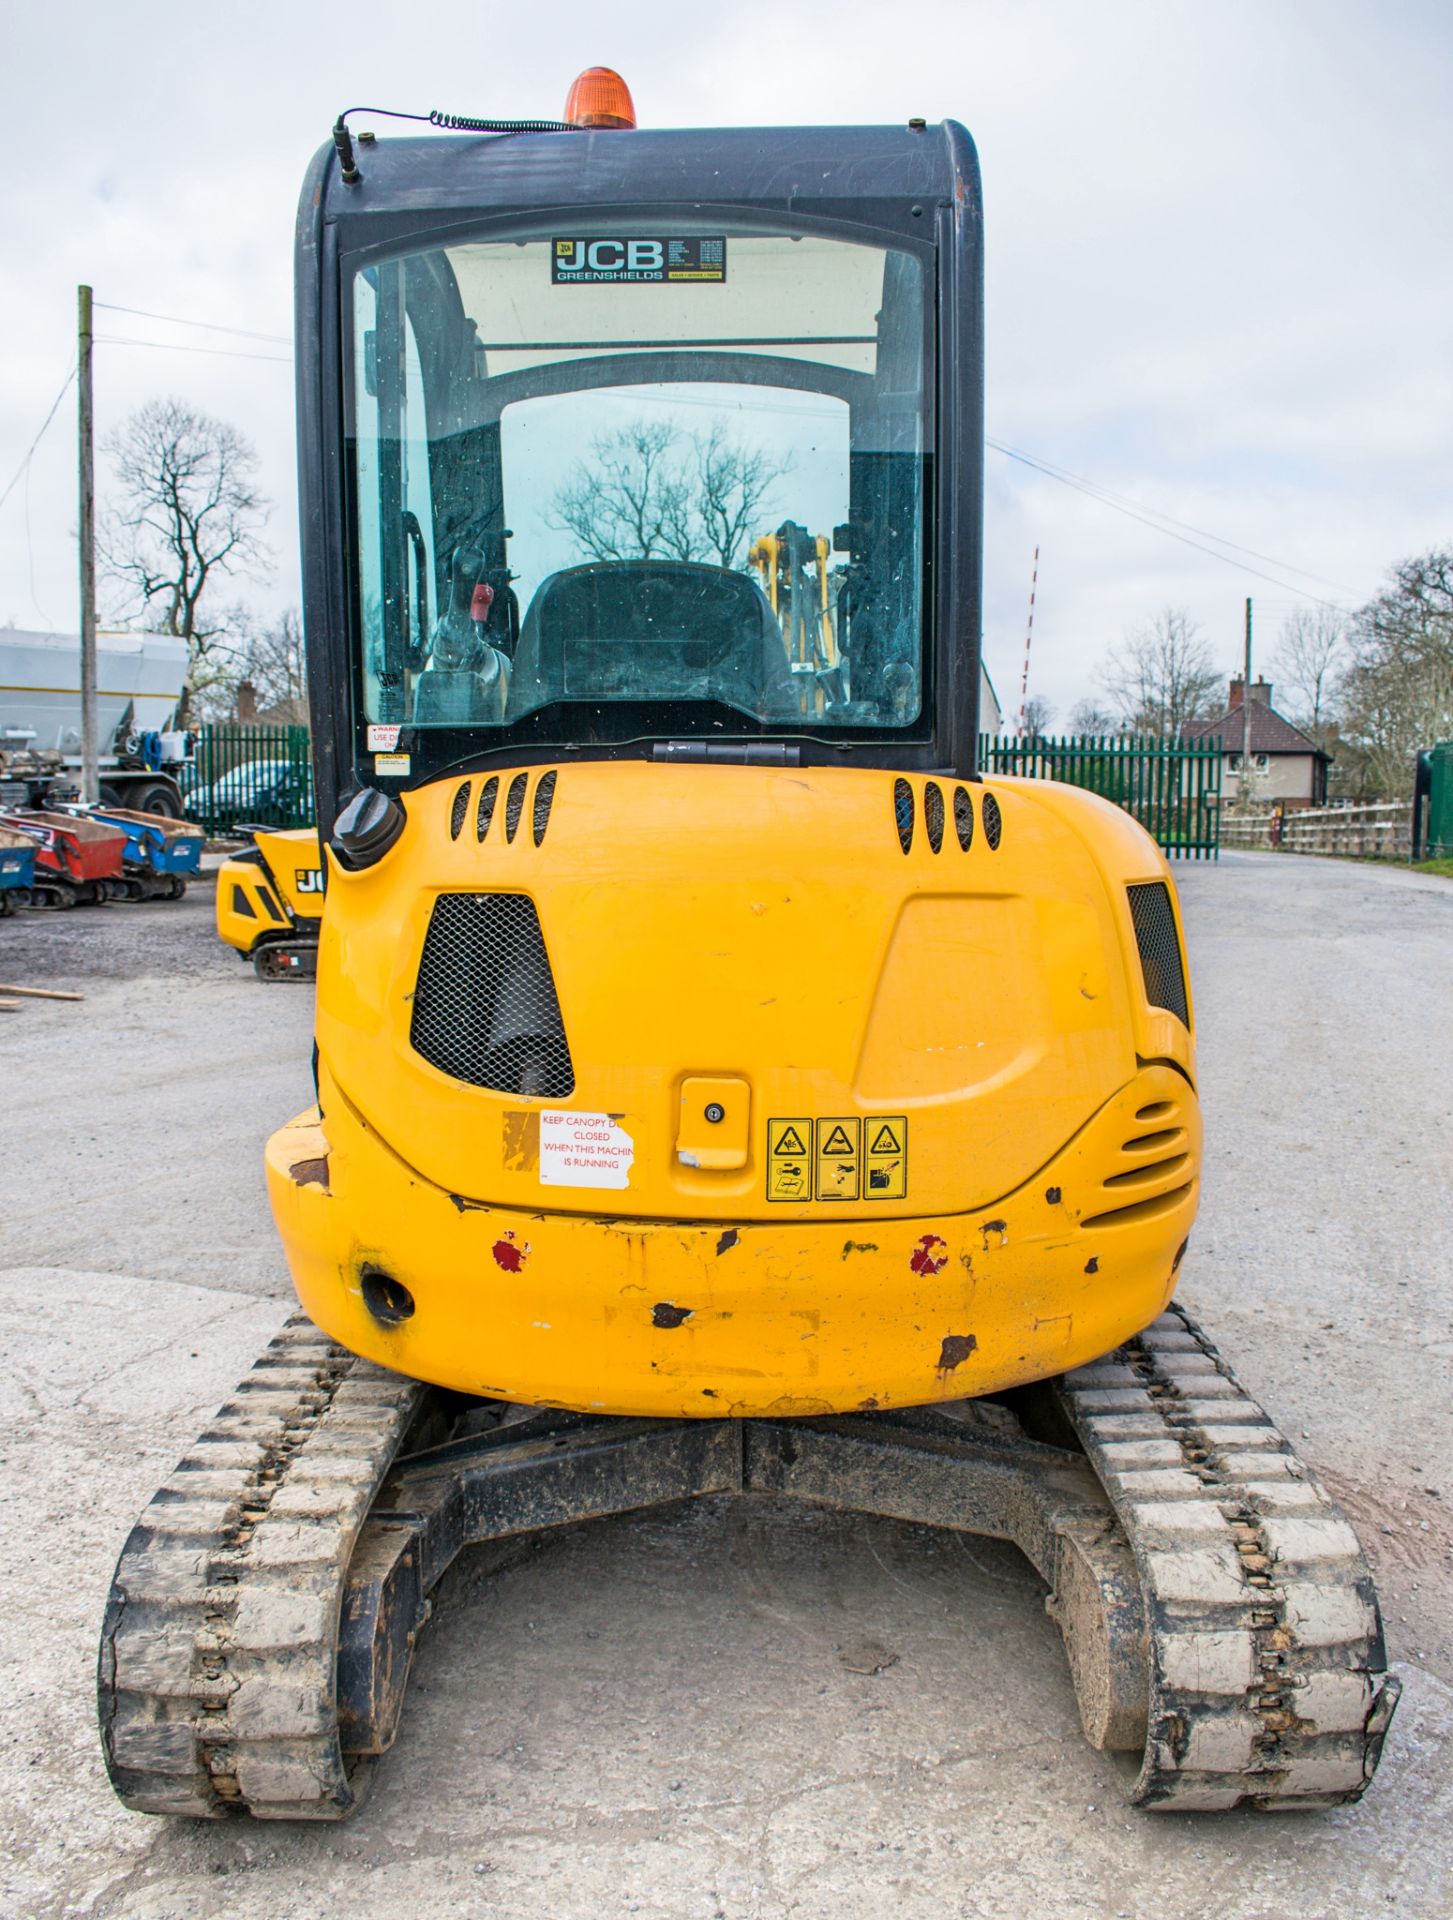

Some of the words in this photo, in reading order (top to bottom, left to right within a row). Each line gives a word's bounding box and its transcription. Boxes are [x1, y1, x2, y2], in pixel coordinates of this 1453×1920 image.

[557, 240, 664, 270] JCB
[557, 271, 663, 281] GREENSHIELDS
[543, 1115, 564, 1125] KEEP
[566, 1117, 606, 1128] CANOPY
[574, 1131, 610, 1141] CLOSED
[544, 1142, 574, 1153] WHEN
[575, 1144, 595, 1154] THIS
[564, 1158, 572, 1167] IS
[574, 1158, 619, 1169] RUNNING
